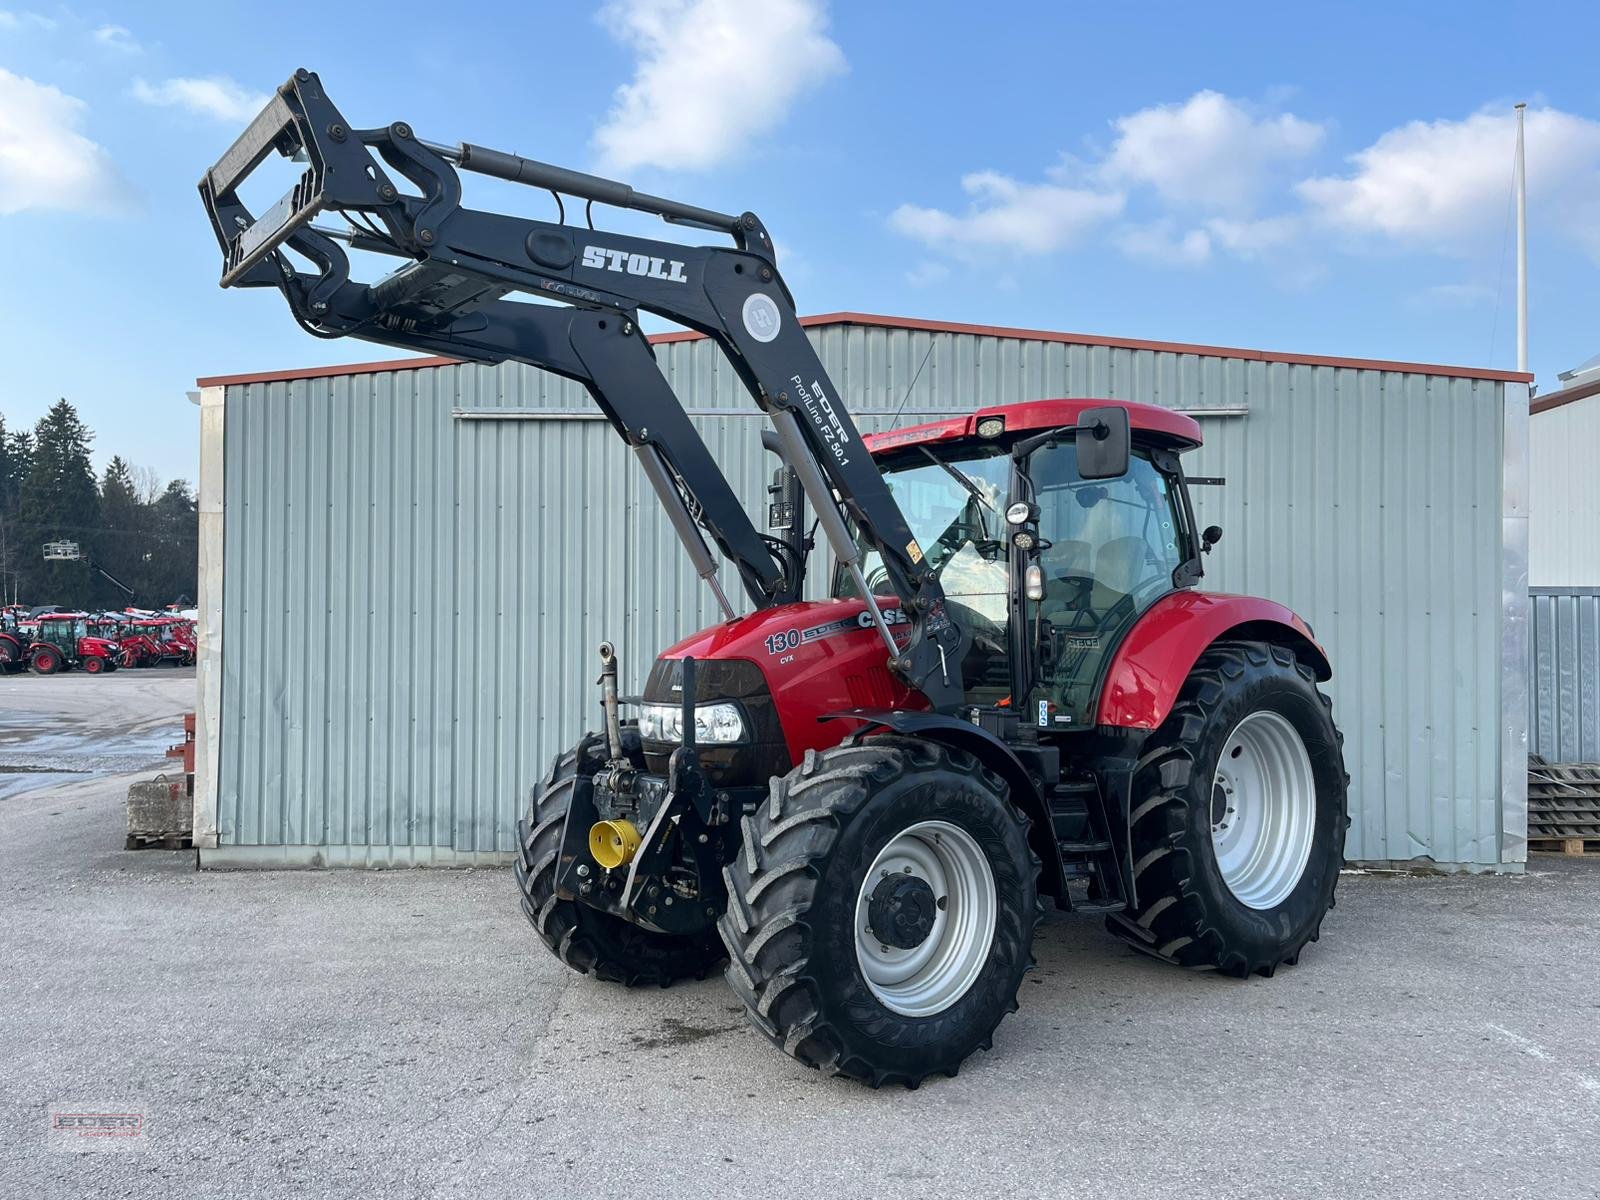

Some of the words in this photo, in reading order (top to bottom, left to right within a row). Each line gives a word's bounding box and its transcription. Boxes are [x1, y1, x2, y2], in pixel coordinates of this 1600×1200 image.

[582, 245, 687, 283] STOLL
[790, 374, 823, 425] ProfiLine
[820, 425, 835, 443] FZ
[831, 441, 850, 466] 50.1
[811, 379, 850, 444] EDER
[765, 628, 800, 655] 130
[780, 654, 794, 665] CVX
